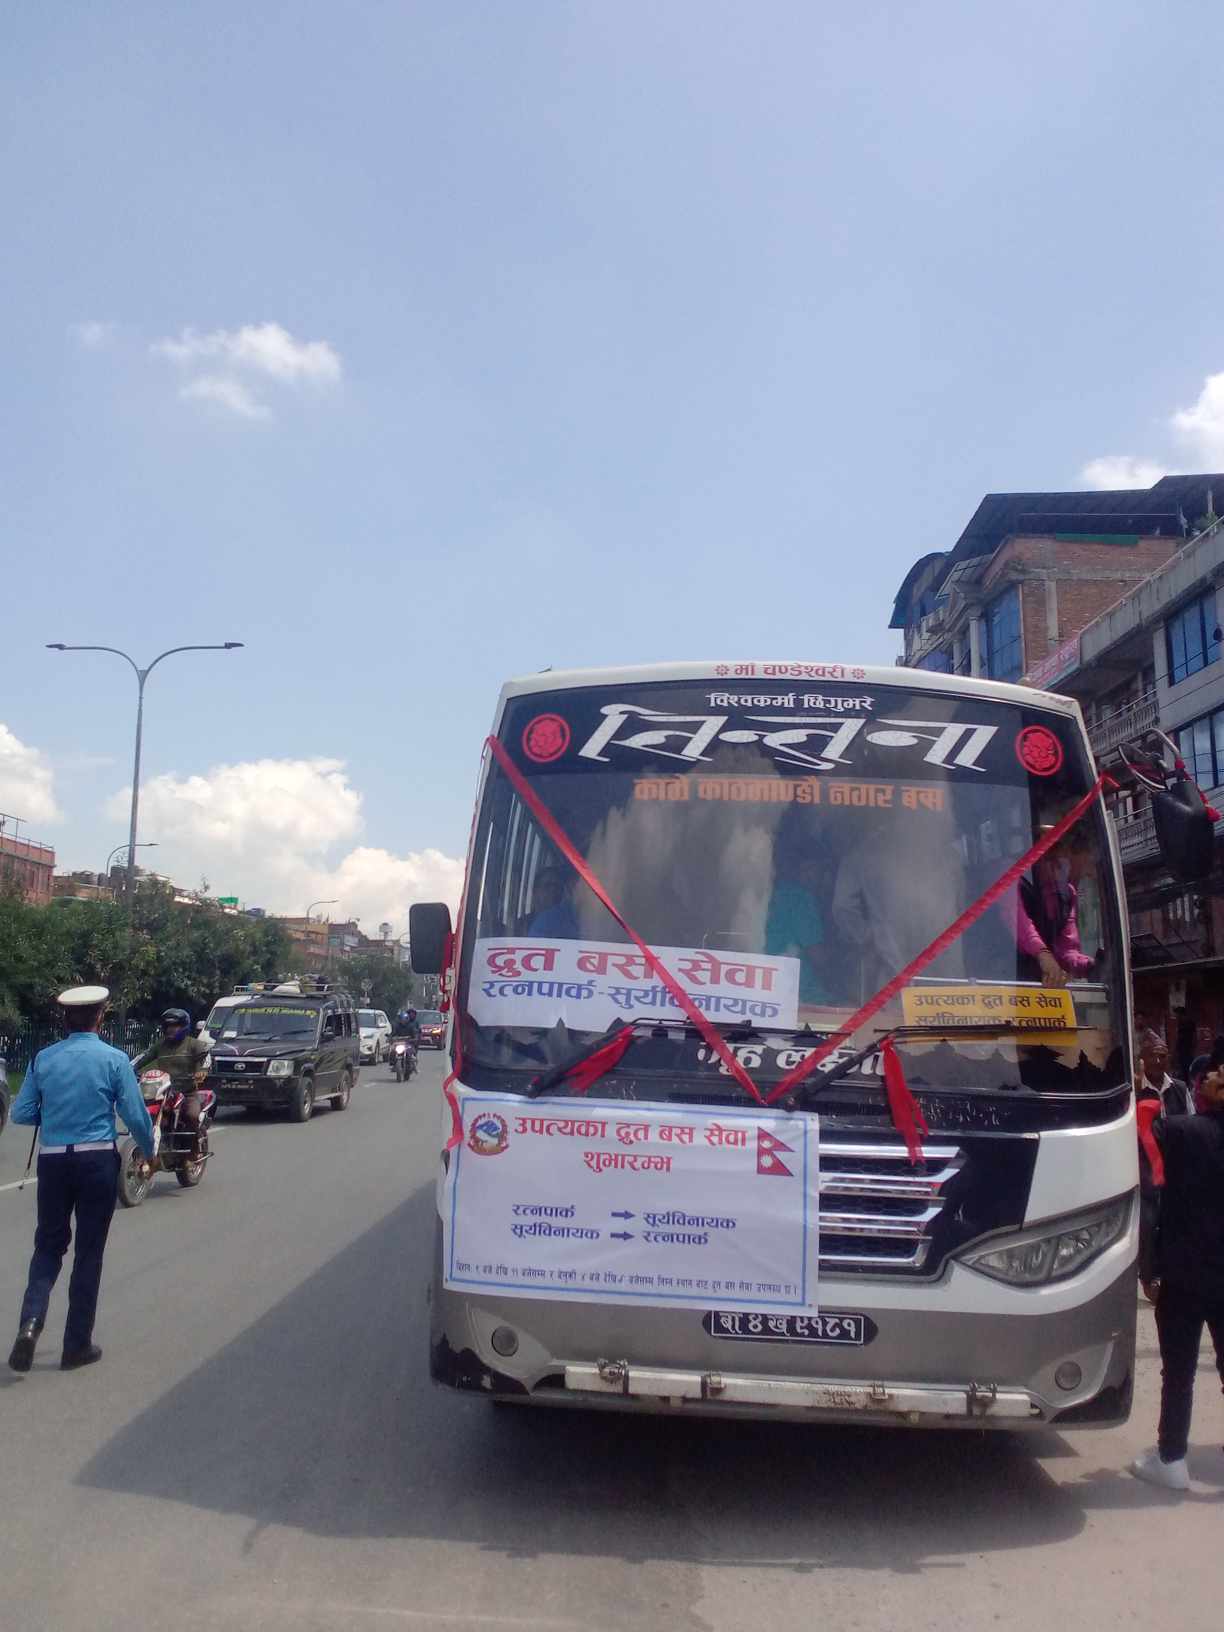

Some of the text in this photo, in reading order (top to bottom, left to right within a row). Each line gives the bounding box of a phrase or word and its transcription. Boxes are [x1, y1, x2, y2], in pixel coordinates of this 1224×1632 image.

[706, 692, 796, 708] विश्वकर्मा
[487, 947, 778, 991] द्रुत बस सेवा
[913, 993, 1062, 1010] उपत्यका द्रुत बस सेवा
[515, 1116, 748, 1147] उपत्यका द्रुत बस सेवा
[583, 1150, 673, 1173] शुभारम्भ
[512, 1203, 737, 1229] रत्नपार्क सूर्यविनायक
[511, 1222, 709, 1246] सूर्यविनायक रत्नपार्क
[719, 1312, 743, 1334] बा
[748, 1314, 763, 1333] ४
[767, 1315, 791, 1336] ख
